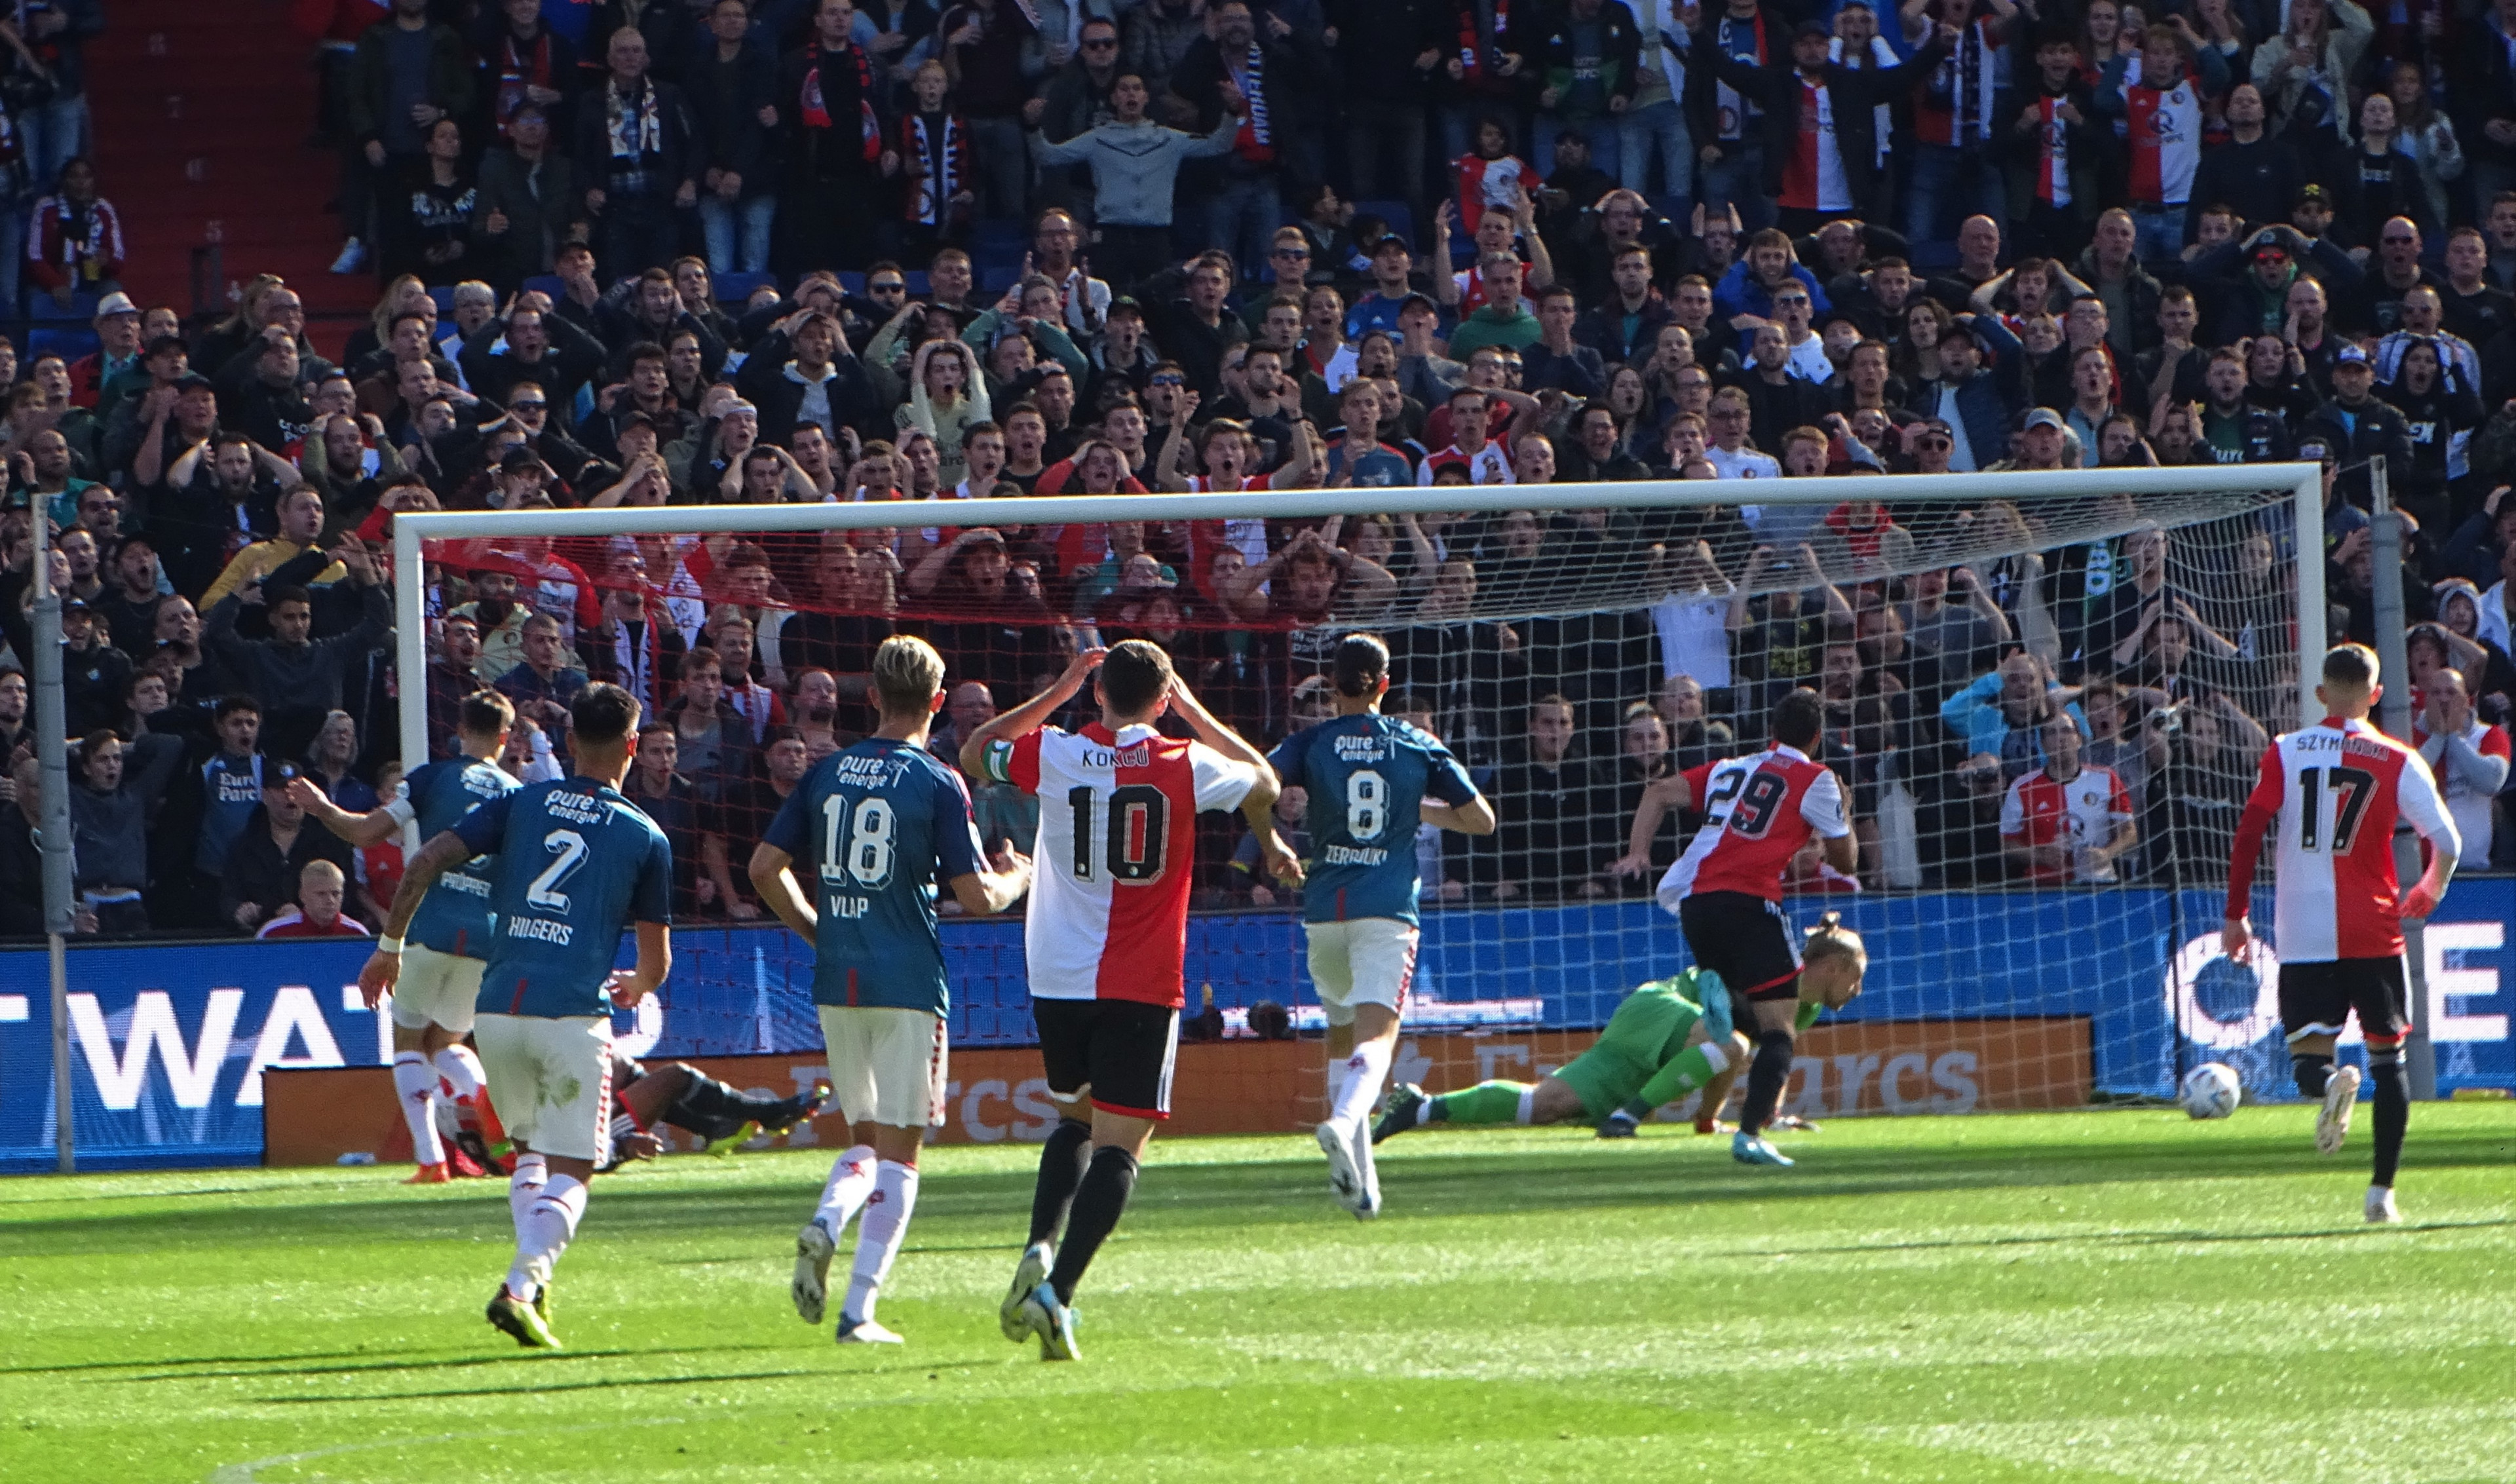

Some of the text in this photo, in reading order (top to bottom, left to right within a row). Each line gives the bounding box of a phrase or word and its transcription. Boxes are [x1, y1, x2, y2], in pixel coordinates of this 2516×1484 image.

[1334, 735, 1374, 754] pure
[837, 755, 884, 776] pure
[219, 772, 257, 786] Eur
[838, 771, 888, 790] energie
[219, 786, 258, 801] Parc
[544, 789, 595, 810] pure
[1705, 767, 1789, 840] 29
[548, 804, 601, 824] energie
[1347, 769, 1390, 843] 8
[2300, 767, 2380, 856] 17
[820, 793, 898, 891] 18
[1069, 784, 1170, 886] 10
[527, 829, 590, 916] 2
[830, 895, 869, 918] VLAP
[1733, 1047, 1979, 1117] arcs
